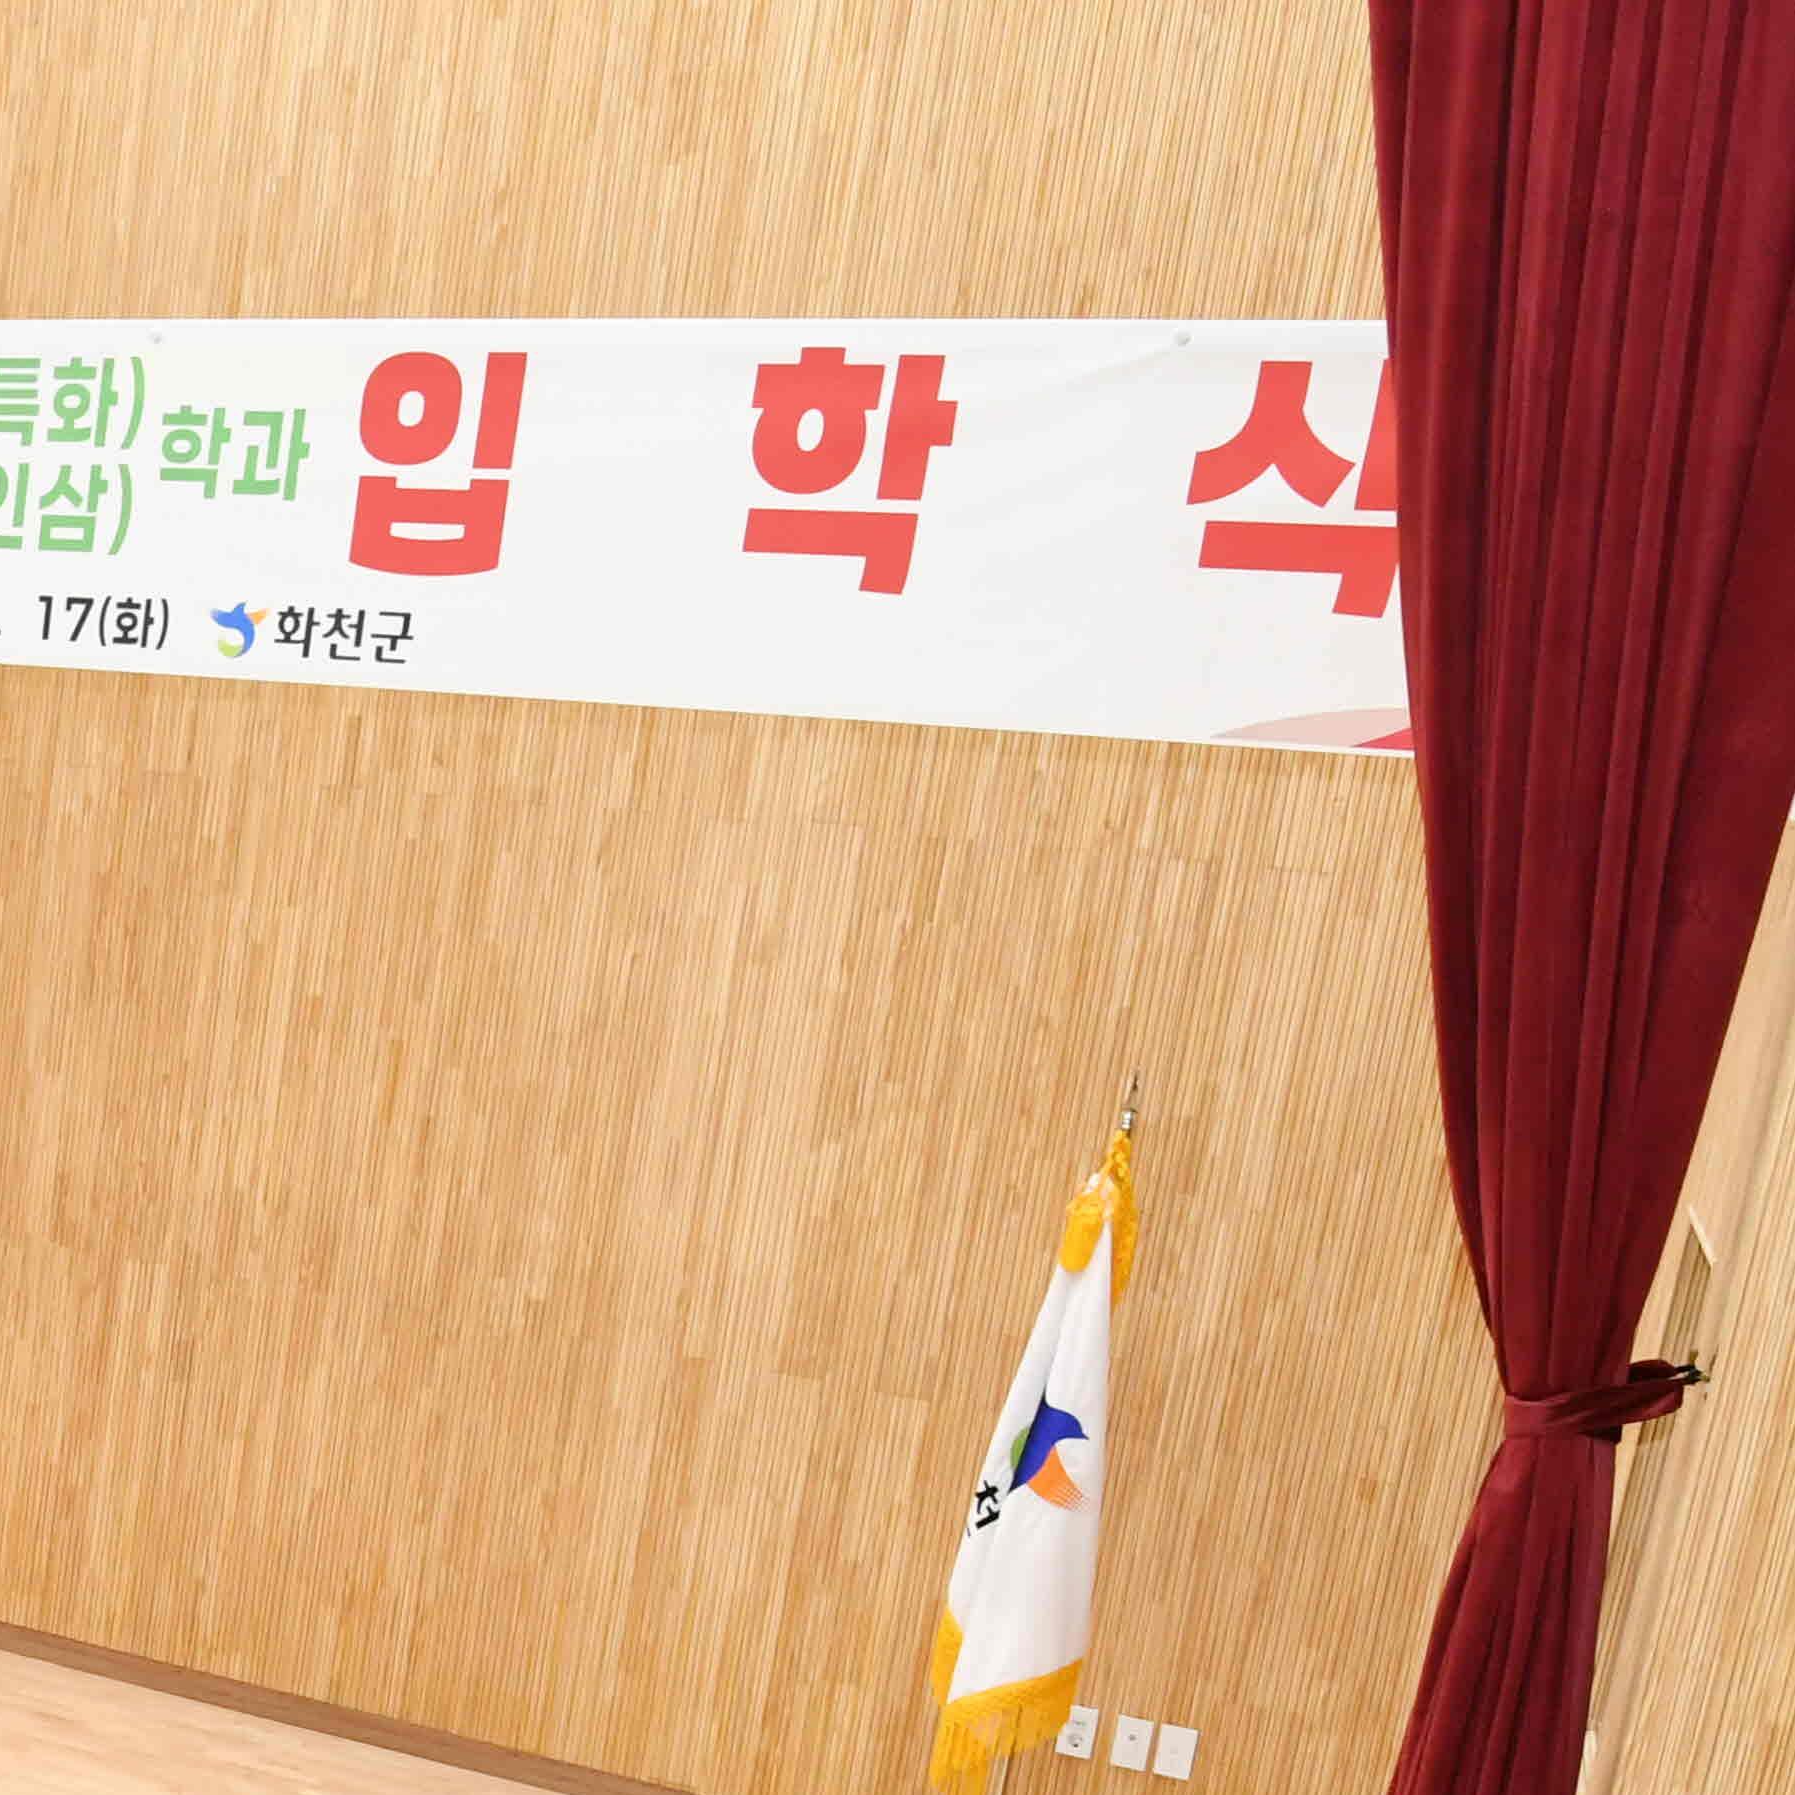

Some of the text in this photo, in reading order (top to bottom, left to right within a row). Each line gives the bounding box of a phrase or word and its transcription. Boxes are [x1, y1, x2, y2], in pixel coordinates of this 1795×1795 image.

[160, 407, 311, 502] 학과
[349, 351, 528, 577] 입
[743, 347, 958, 596] 학
[39, 595, 169, 650] 17(화)
[274, 605, 414, 664] 화천군
